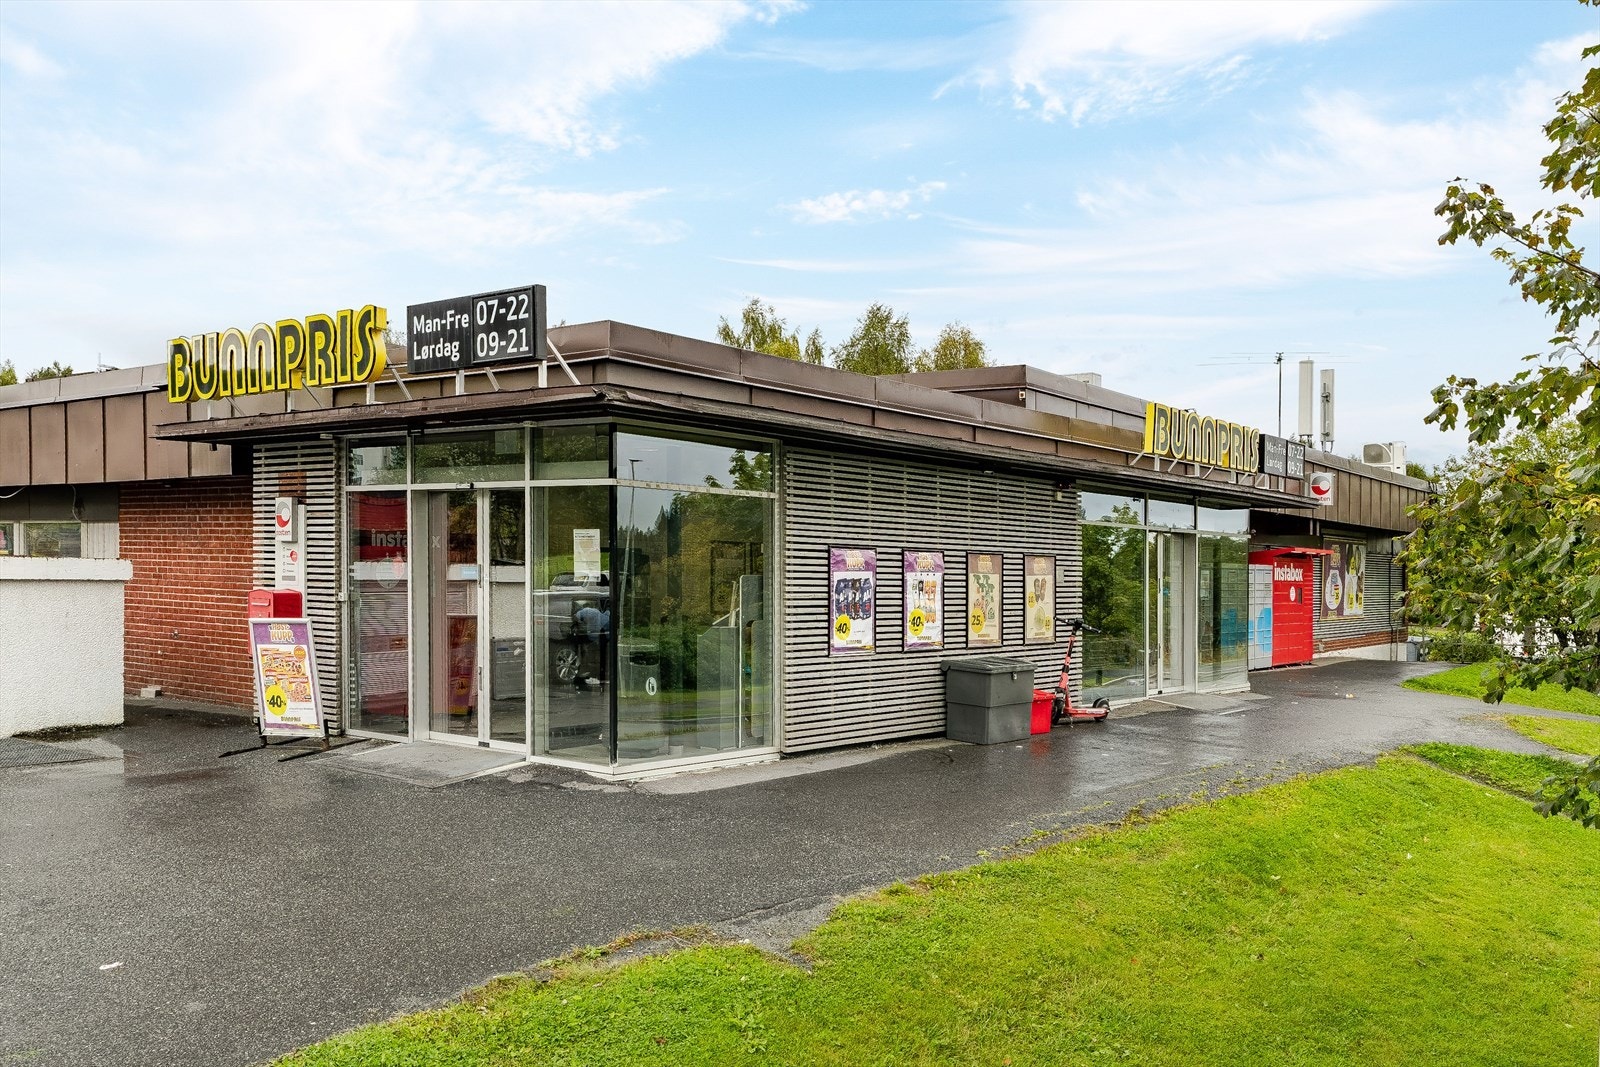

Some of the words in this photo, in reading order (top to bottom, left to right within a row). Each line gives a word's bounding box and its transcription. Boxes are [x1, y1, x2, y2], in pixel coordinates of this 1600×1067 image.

[413, 309, 469, 335] Man-Fre
[476, 294, 529, 325] 07-22
[167, 304, 387, 404] BUNNPRIS
[413, 338, 460, 362] Lørdag
[476, 328, 529, 358] 09-21
[1152, 402, 1260, 474] BUNNPRIS
[1266, 442, 1286, 456] Man-Fre
[1288, 444, 1304, 460] 07-22
[1266, 457, 1283, 473] Lørdag
[1288, 460, 1304, 476] 09-21
[1274, 562, 1304, 582] instabox
